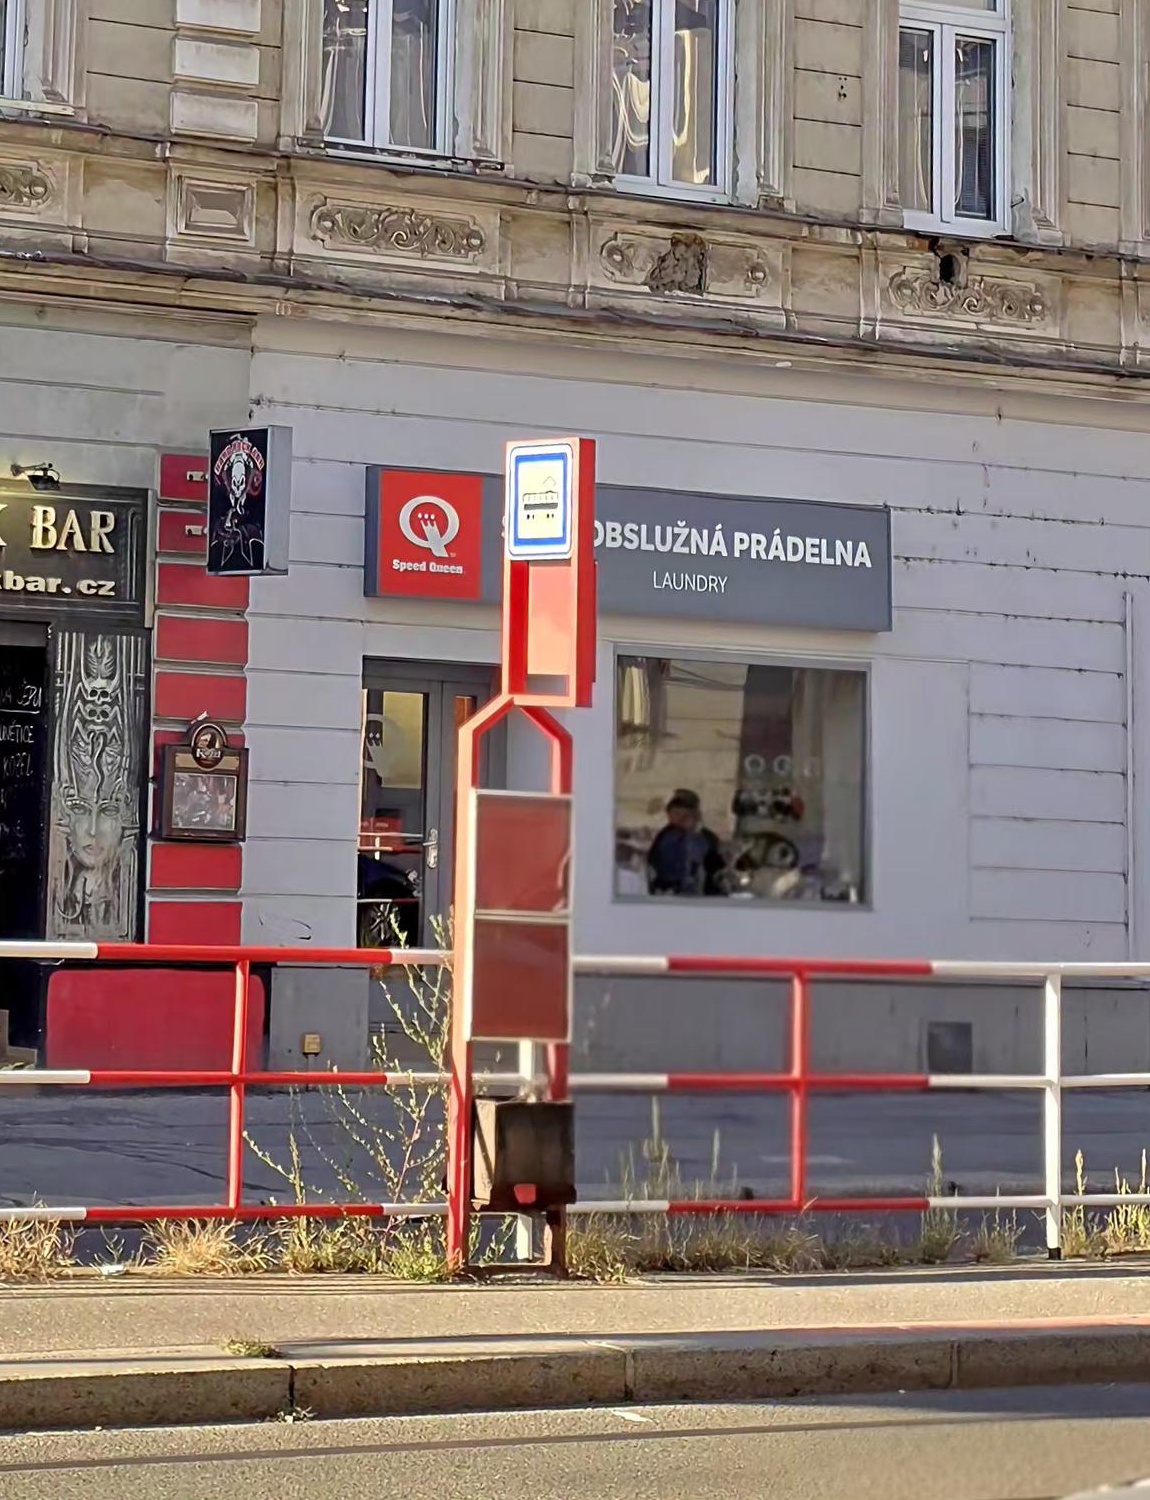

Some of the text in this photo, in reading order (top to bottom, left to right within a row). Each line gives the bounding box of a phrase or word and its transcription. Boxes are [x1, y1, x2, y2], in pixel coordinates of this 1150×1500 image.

[29, 504, 116, 554] BAR
[734, 527, 873, 568] PRÁDELNA
[392, 559, 464, 574] Speed Queen
[653, 570, 729, 594] LAUNDRY
